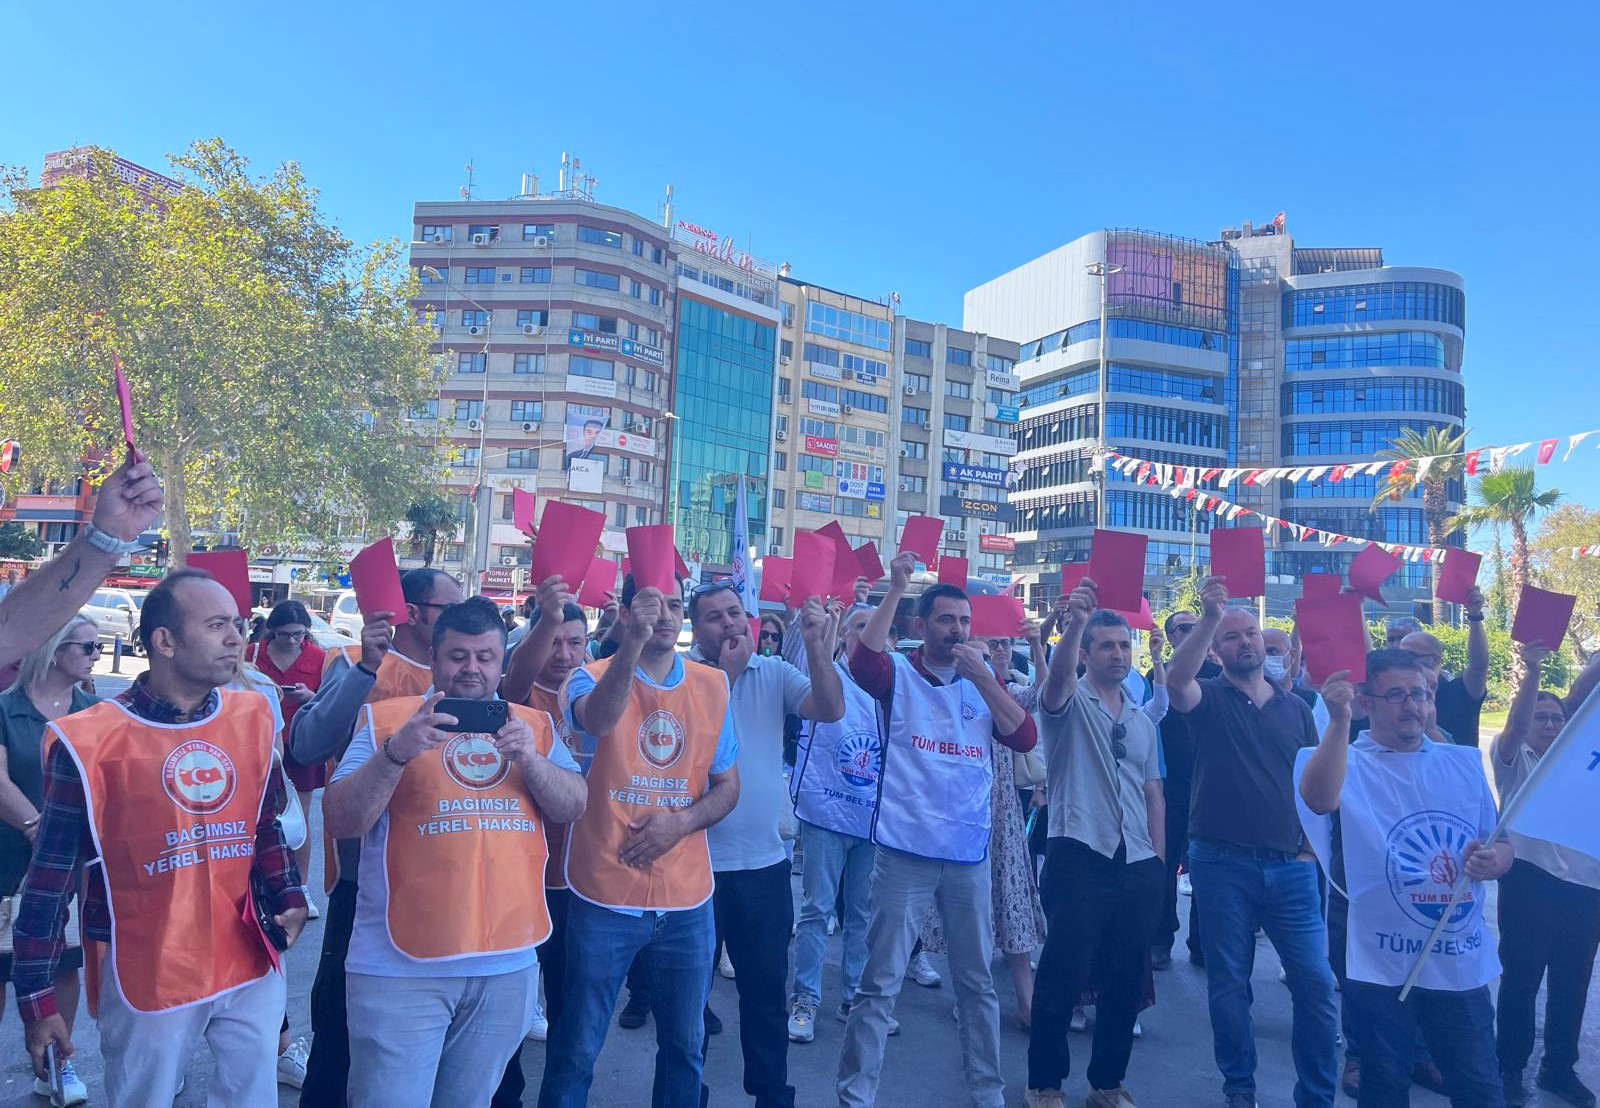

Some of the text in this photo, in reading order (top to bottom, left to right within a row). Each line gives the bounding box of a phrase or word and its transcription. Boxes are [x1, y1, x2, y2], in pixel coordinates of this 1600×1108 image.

[596, 335, 617, 346] PARTİ
[644, 349, 663, 360] PARTİ
[990, 373, 1010, 385] Reina
[815, 441, 838, 450] SAADET
[960, 468, 1002, 481] AK PARTİ
[187, 743, 207, 752] YEREL
[911, 734, 983, 758] TÜM BEL-SEN
[438, 796, 520, 812] BAĞIMSIZ
[609, 789, 651, 806] YEREL
[846, 795, 877, 809] BEL-SE
[164, 820, 247, 847] BAĞIMSIZ
[417, 817, 536, 837] YEREL HAKSEN
[143, 845, 205, 877] YEREL
[1410, 892, 1438, 903] TÜM
[1376, 931, 1482, 956] TÜM BEL-SE
